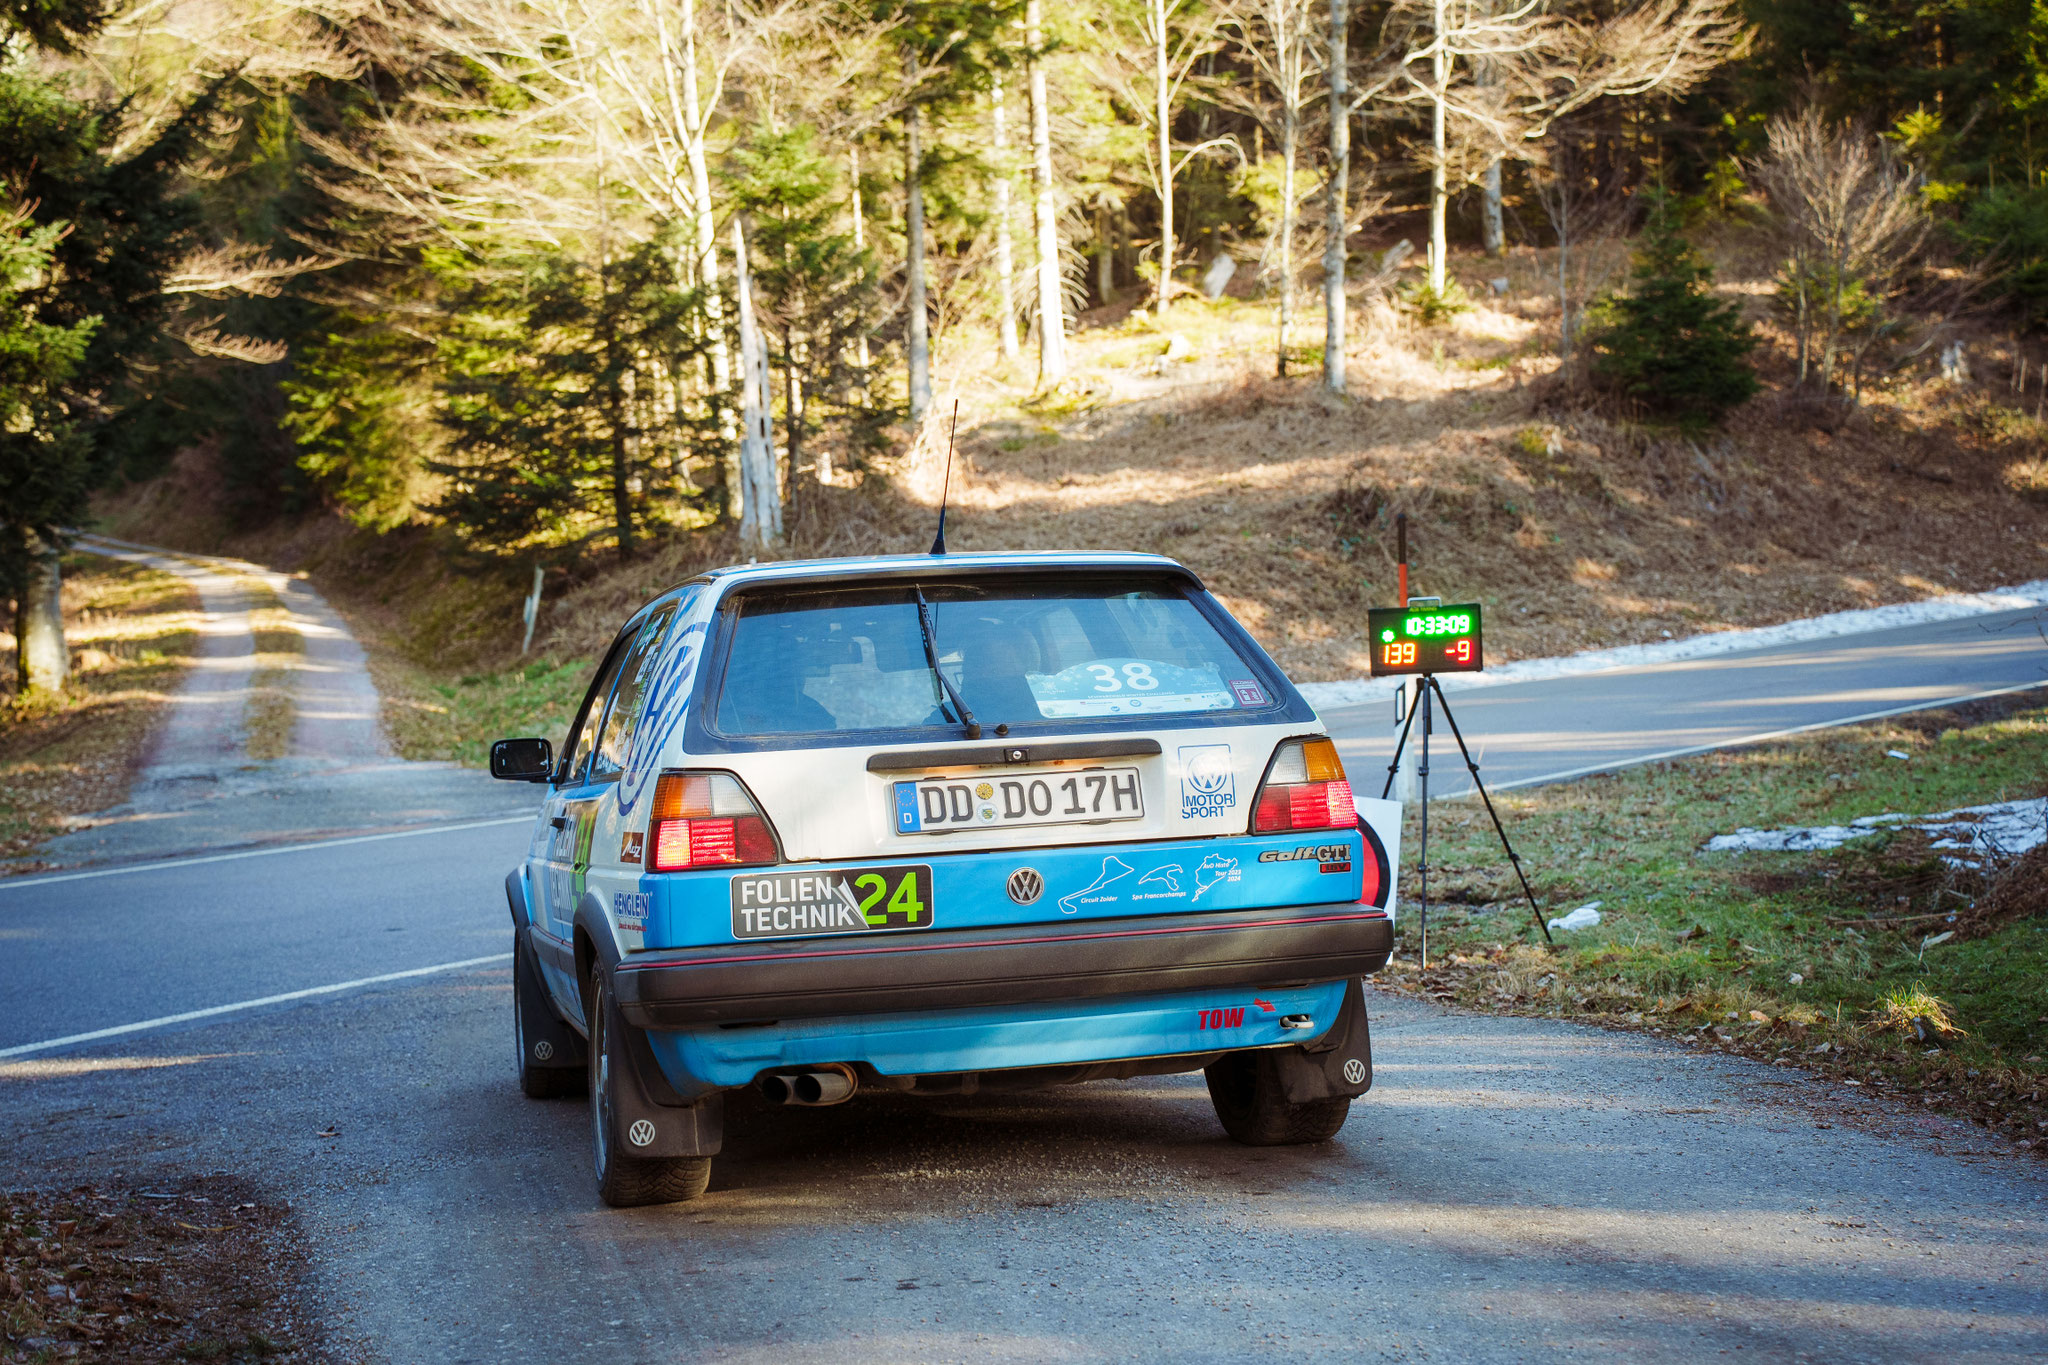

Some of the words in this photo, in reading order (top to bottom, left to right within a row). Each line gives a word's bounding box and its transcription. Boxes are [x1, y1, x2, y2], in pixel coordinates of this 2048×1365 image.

[1406, 615, 1470, 635] 10:33:09
[1384, 642, 1416, 664] 139
[1445, 640, 1470, 661] -9
[1086, 662, 1159, 692] 38
[920, 785, 974, 824] DD
[1000, 779, 1053, 819] DO
[1061, 774, 1139, 815] 17H
[1185, 793, 1233, 807] MOTOR
[903, 812, 913, 824] D
[1182, 806, 1225, 819] SPORT
[1258, 847, 1316, 863] Golf
[1316, 844, 1351, 862] GTI
[741, 876, 832, 905] FOLIEN
[1006, 866, 1045, 906] VW
[1144, 891, 1187, 899] Francorchamps
[613, 892, 649, 919] HENGLEIN
[854, 872, 924, 925] 24
[1080, 896, 1100, 904] Circuit
[741, 903, 855, 932] TECHNIK
[1198, 1008, 1245, 1030] TOW
